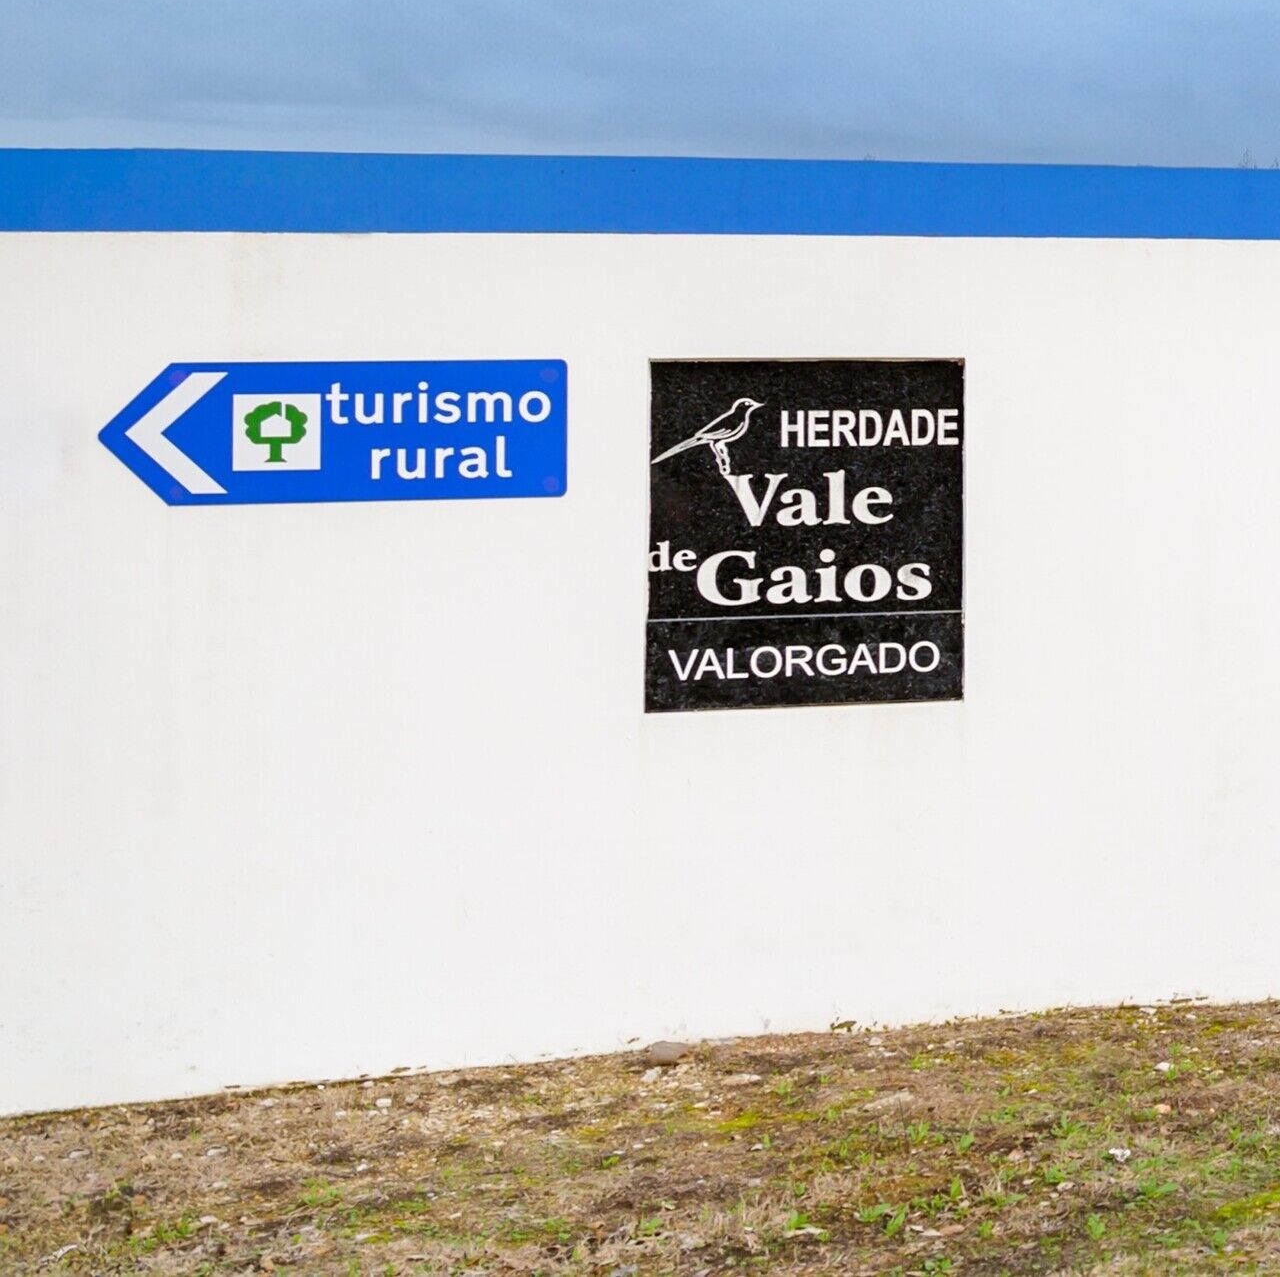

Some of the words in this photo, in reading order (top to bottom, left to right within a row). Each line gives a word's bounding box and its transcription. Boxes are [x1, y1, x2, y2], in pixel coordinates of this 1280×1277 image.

[326, 382, 551, 424] turismo
[780, 409, 959, 447] HERDADE
[371, 435, 513, 480] rural
[723, 469, 894, 527] Vale
[647, 540, 697, 572] de
[697, 548, 933, 606] Gaios
[668, 640, 941, 681] VALORGADO
